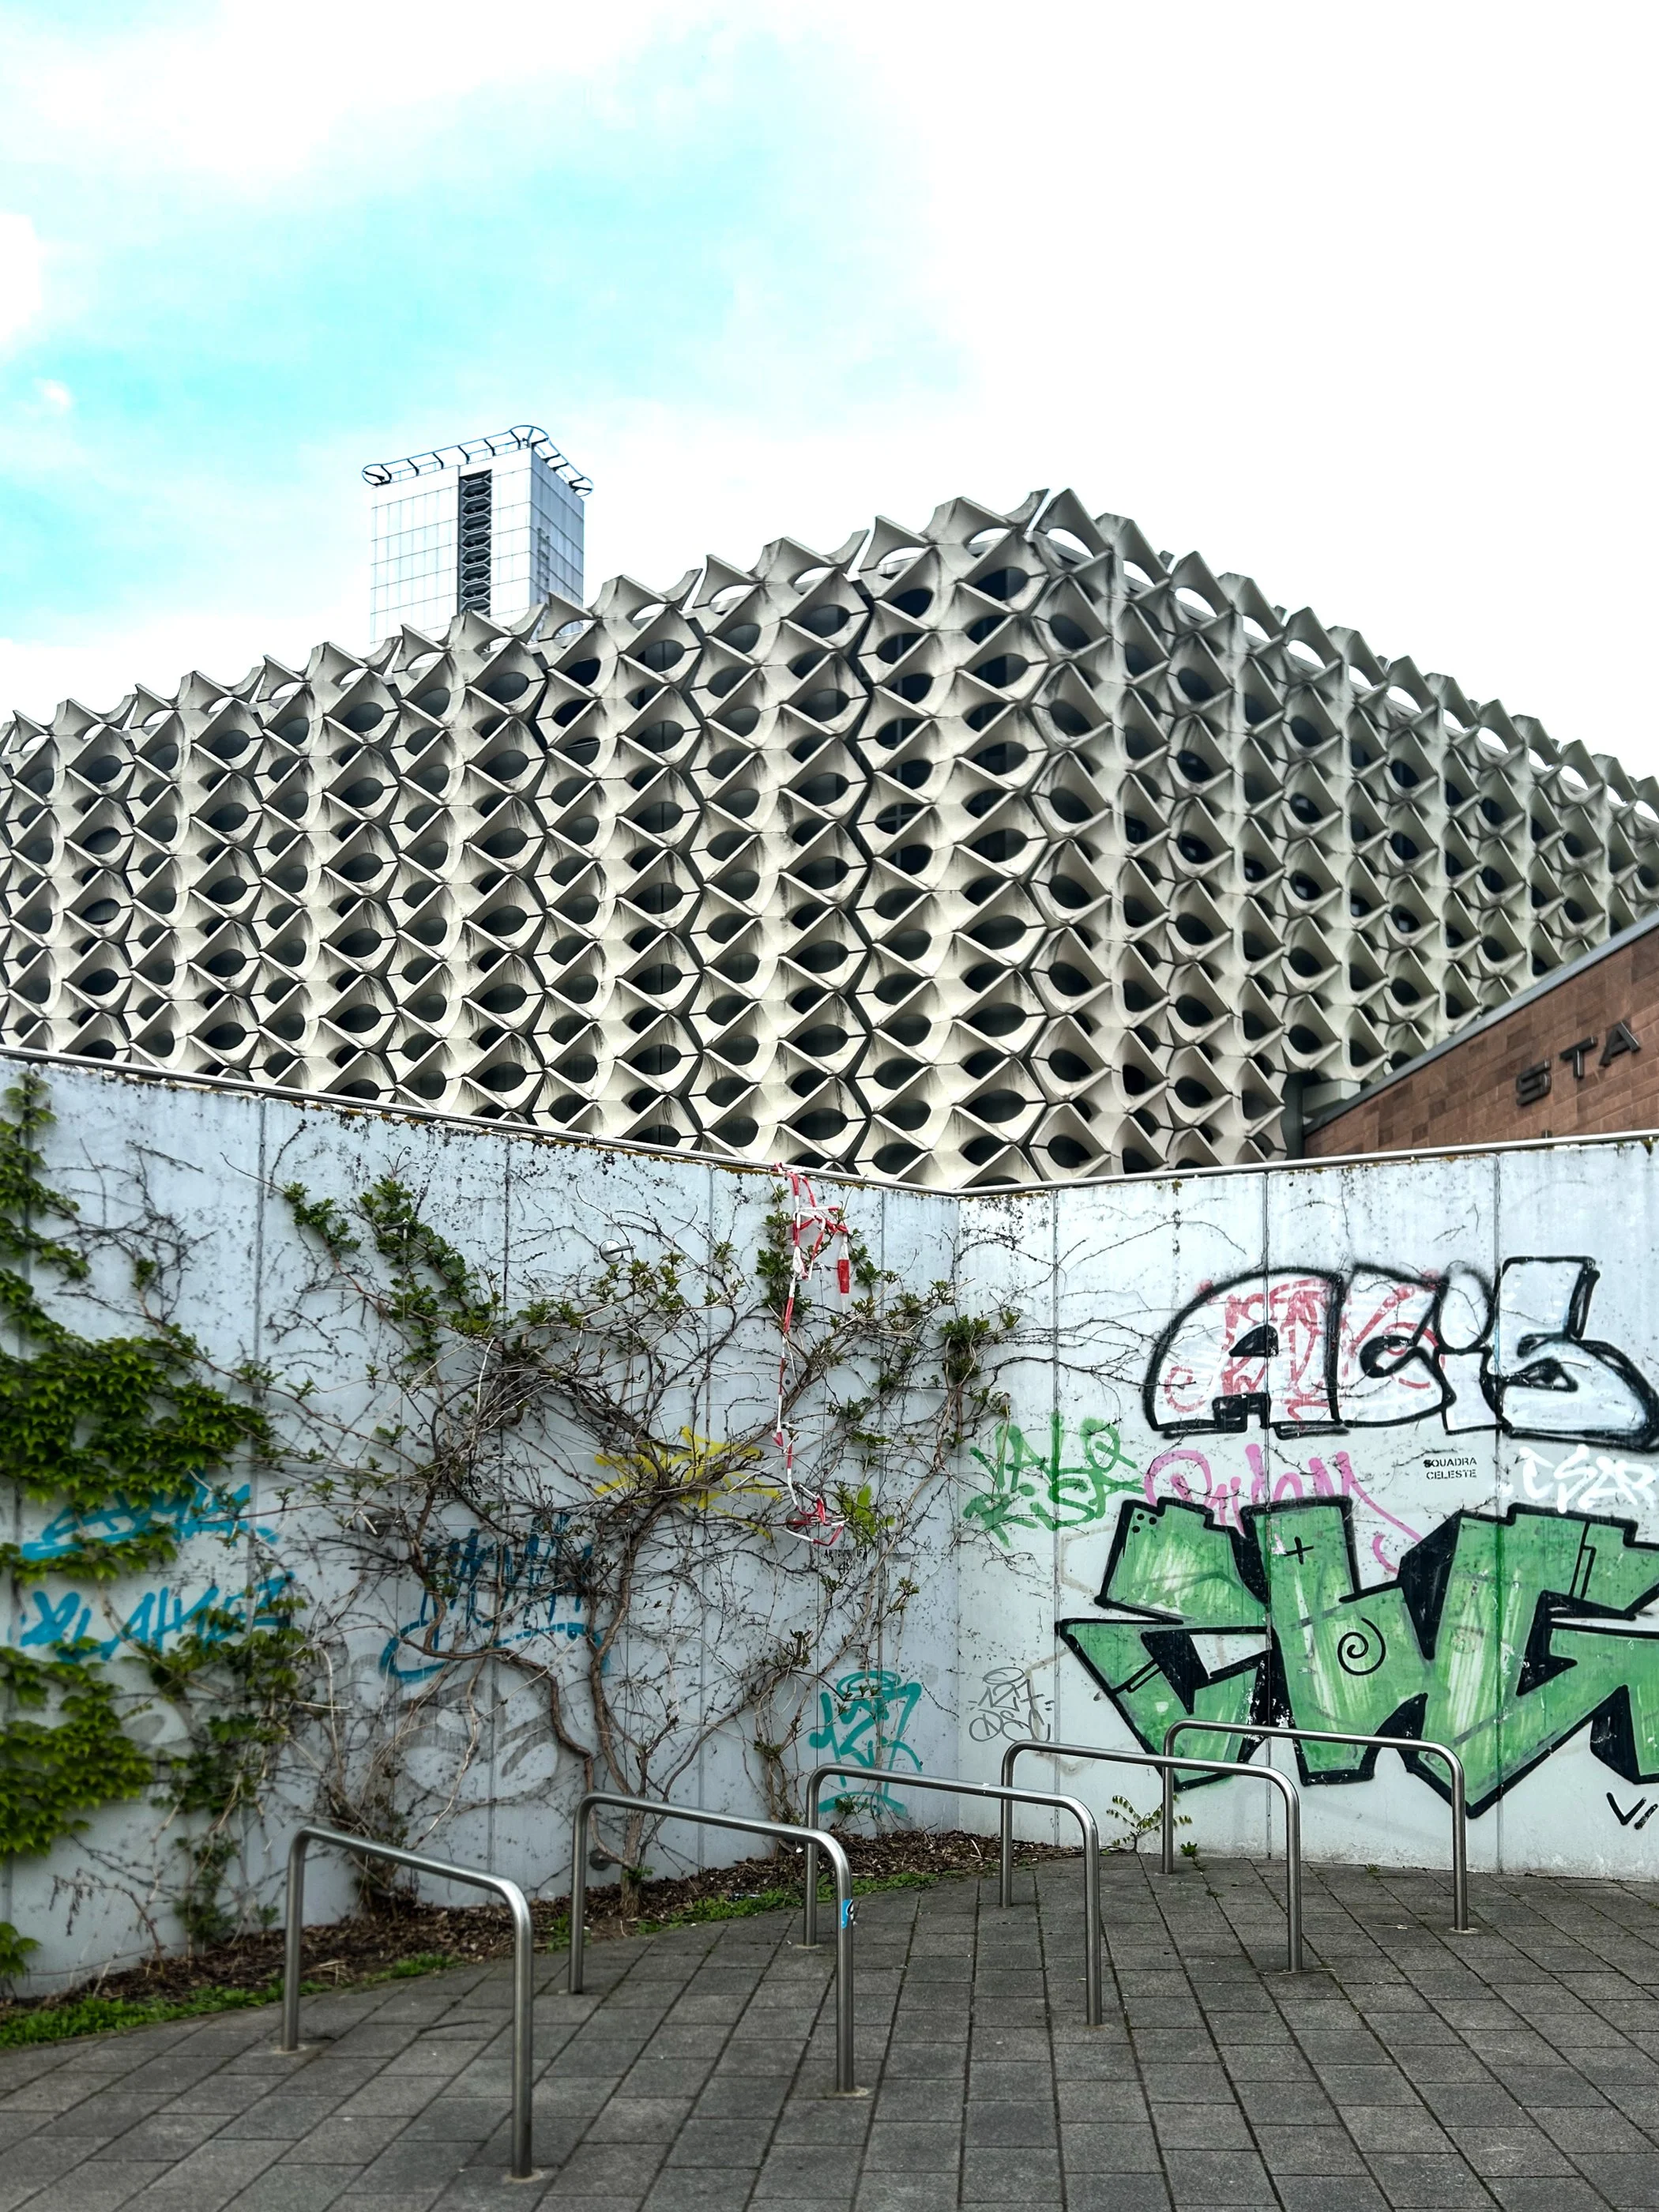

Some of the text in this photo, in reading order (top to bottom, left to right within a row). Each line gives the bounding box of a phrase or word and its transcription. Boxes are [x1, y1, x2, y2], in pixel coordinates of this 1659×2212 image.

[1516, 1020, 1641, 1107] STA
[1423, 1458, 1477, 1468] SQUADRA
[1425, 1469, 1477, 1480] CELESTE
